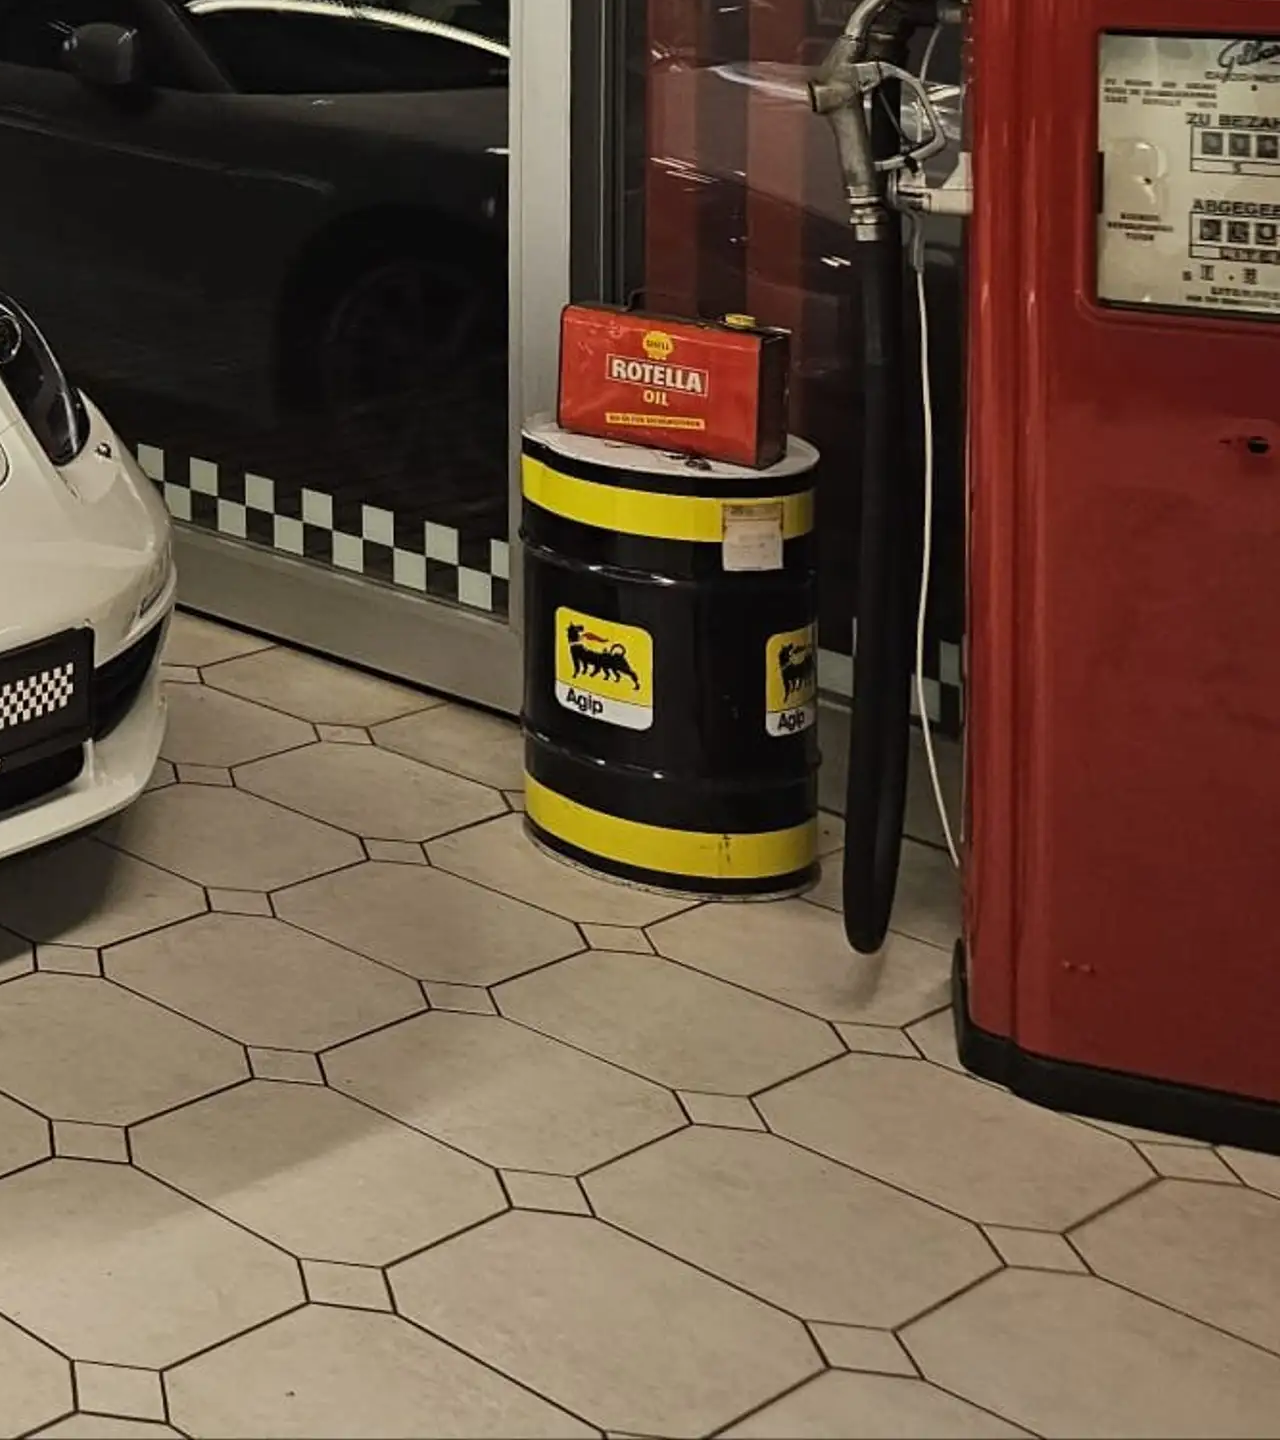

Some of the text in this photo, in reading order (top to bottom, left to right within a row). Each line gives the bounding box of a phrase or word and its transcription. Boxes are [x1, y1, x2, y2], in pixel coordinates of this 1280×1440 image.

[1185, 112, 1211, 126] ZU
[611, 358, 702, 392] ROTELLA
[643, 389, 669, 407] OIL
[566, 688, 604, 715] Agip
[777, 710, 806, 731] Agip
